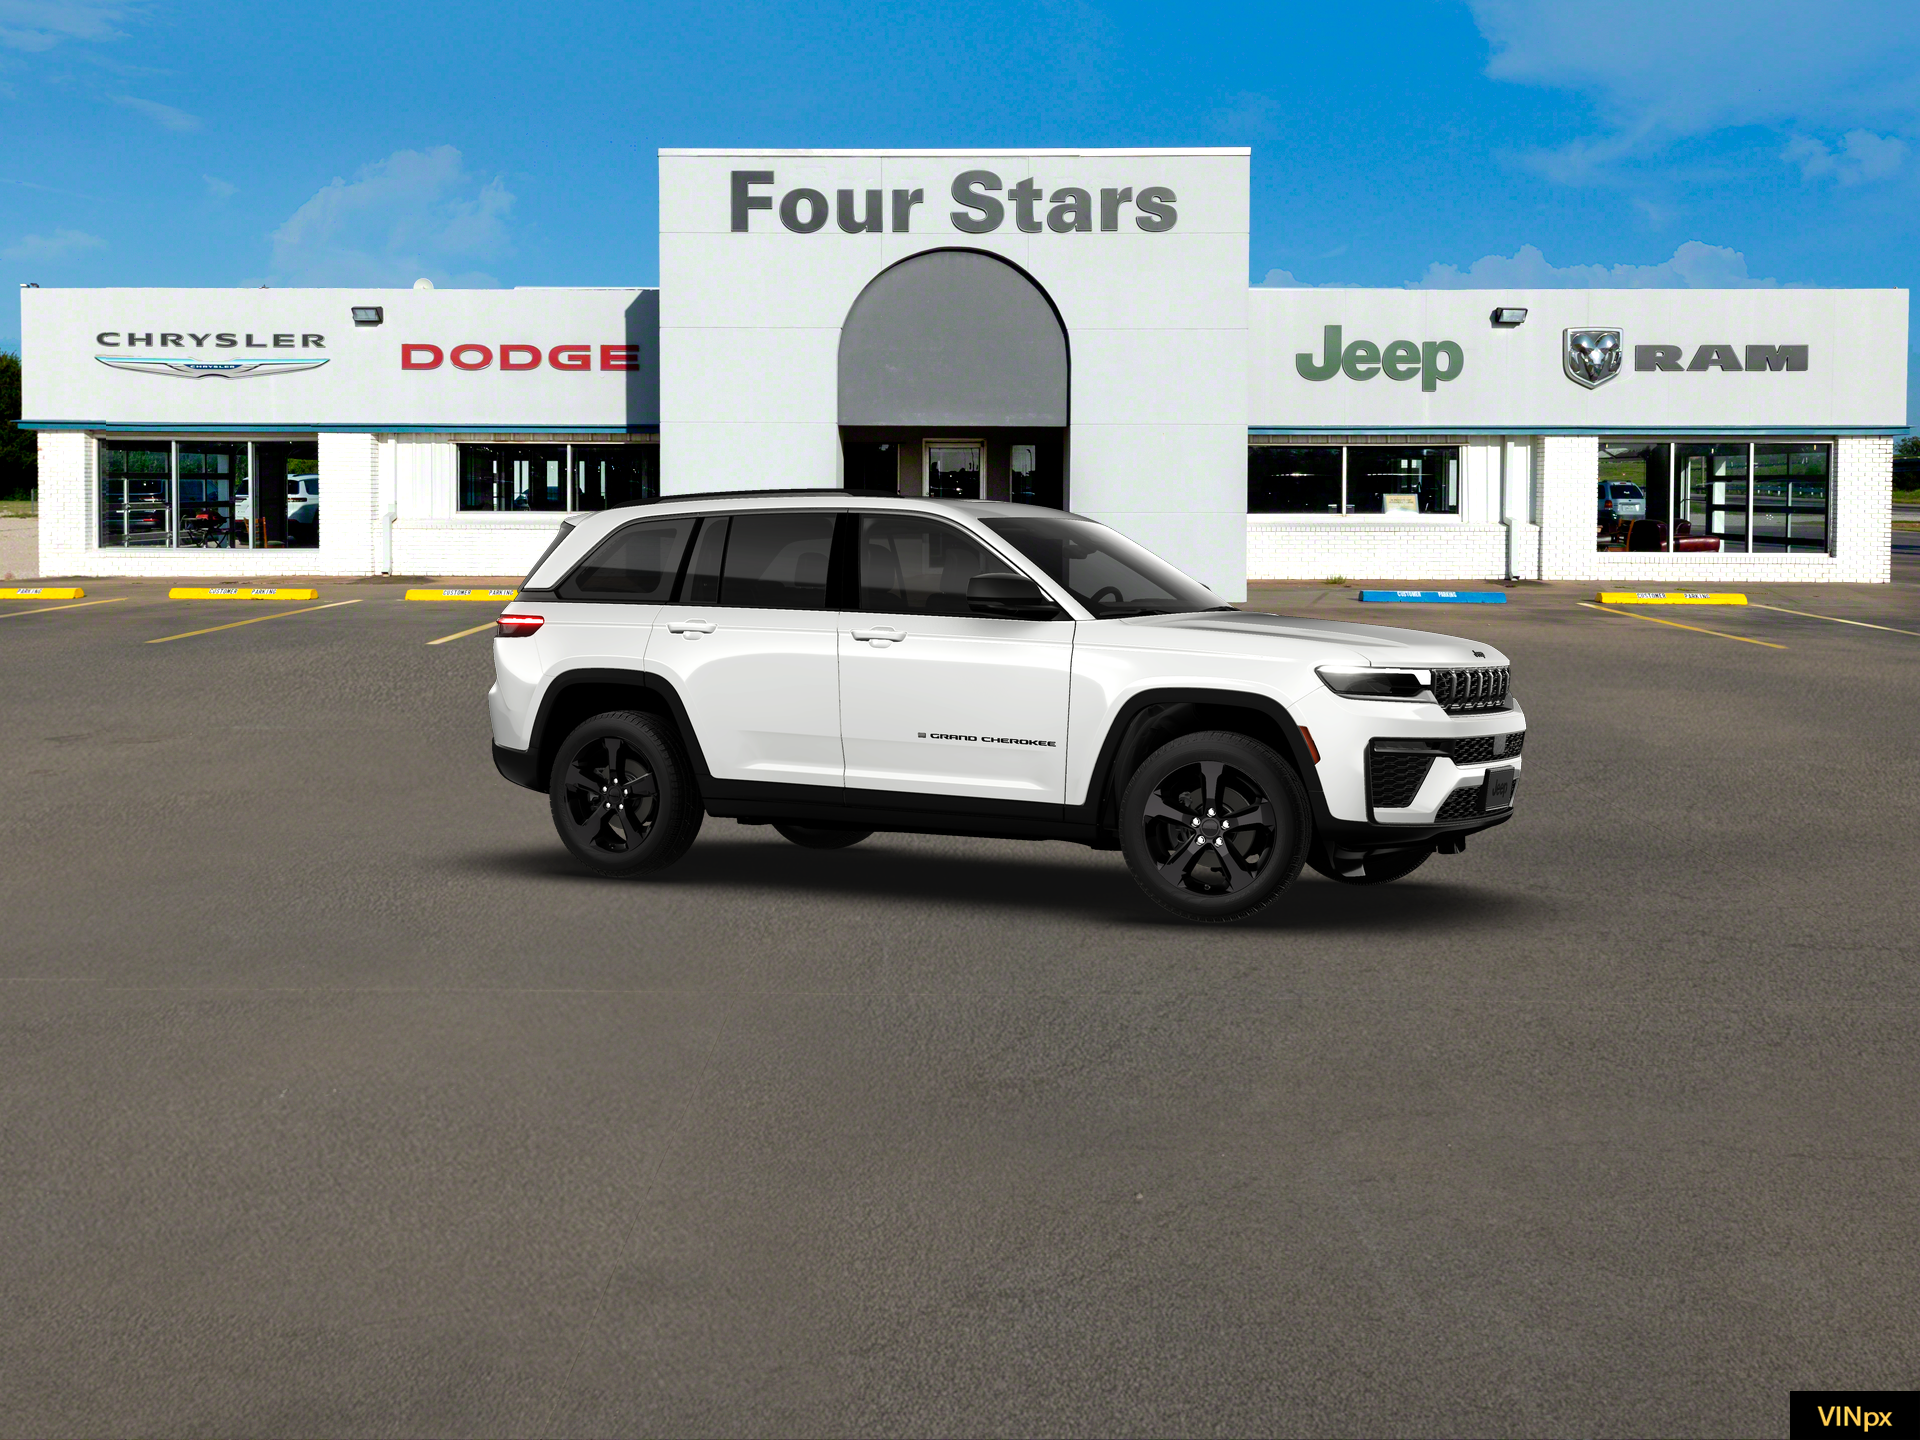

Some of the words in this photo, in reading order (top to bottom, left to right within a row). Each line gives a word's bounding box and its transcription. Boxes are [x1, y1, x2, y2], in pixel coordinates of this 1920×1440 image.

[730, 170, 924, 233] Four
[949, 170, 1178, 233] Stars
[96, 332, 326, 348] CHRYSLER
[401, 344, 641, 371] DODGE
[1295, 325, 1464, 392] Jeep
[1634, 344, 1809, 371] RAM
[930, 733, 978, 742] GRAND
[981, 736, 1057, 747] CHEROKEE
[1491, 778, 1509, 798] Jeep
